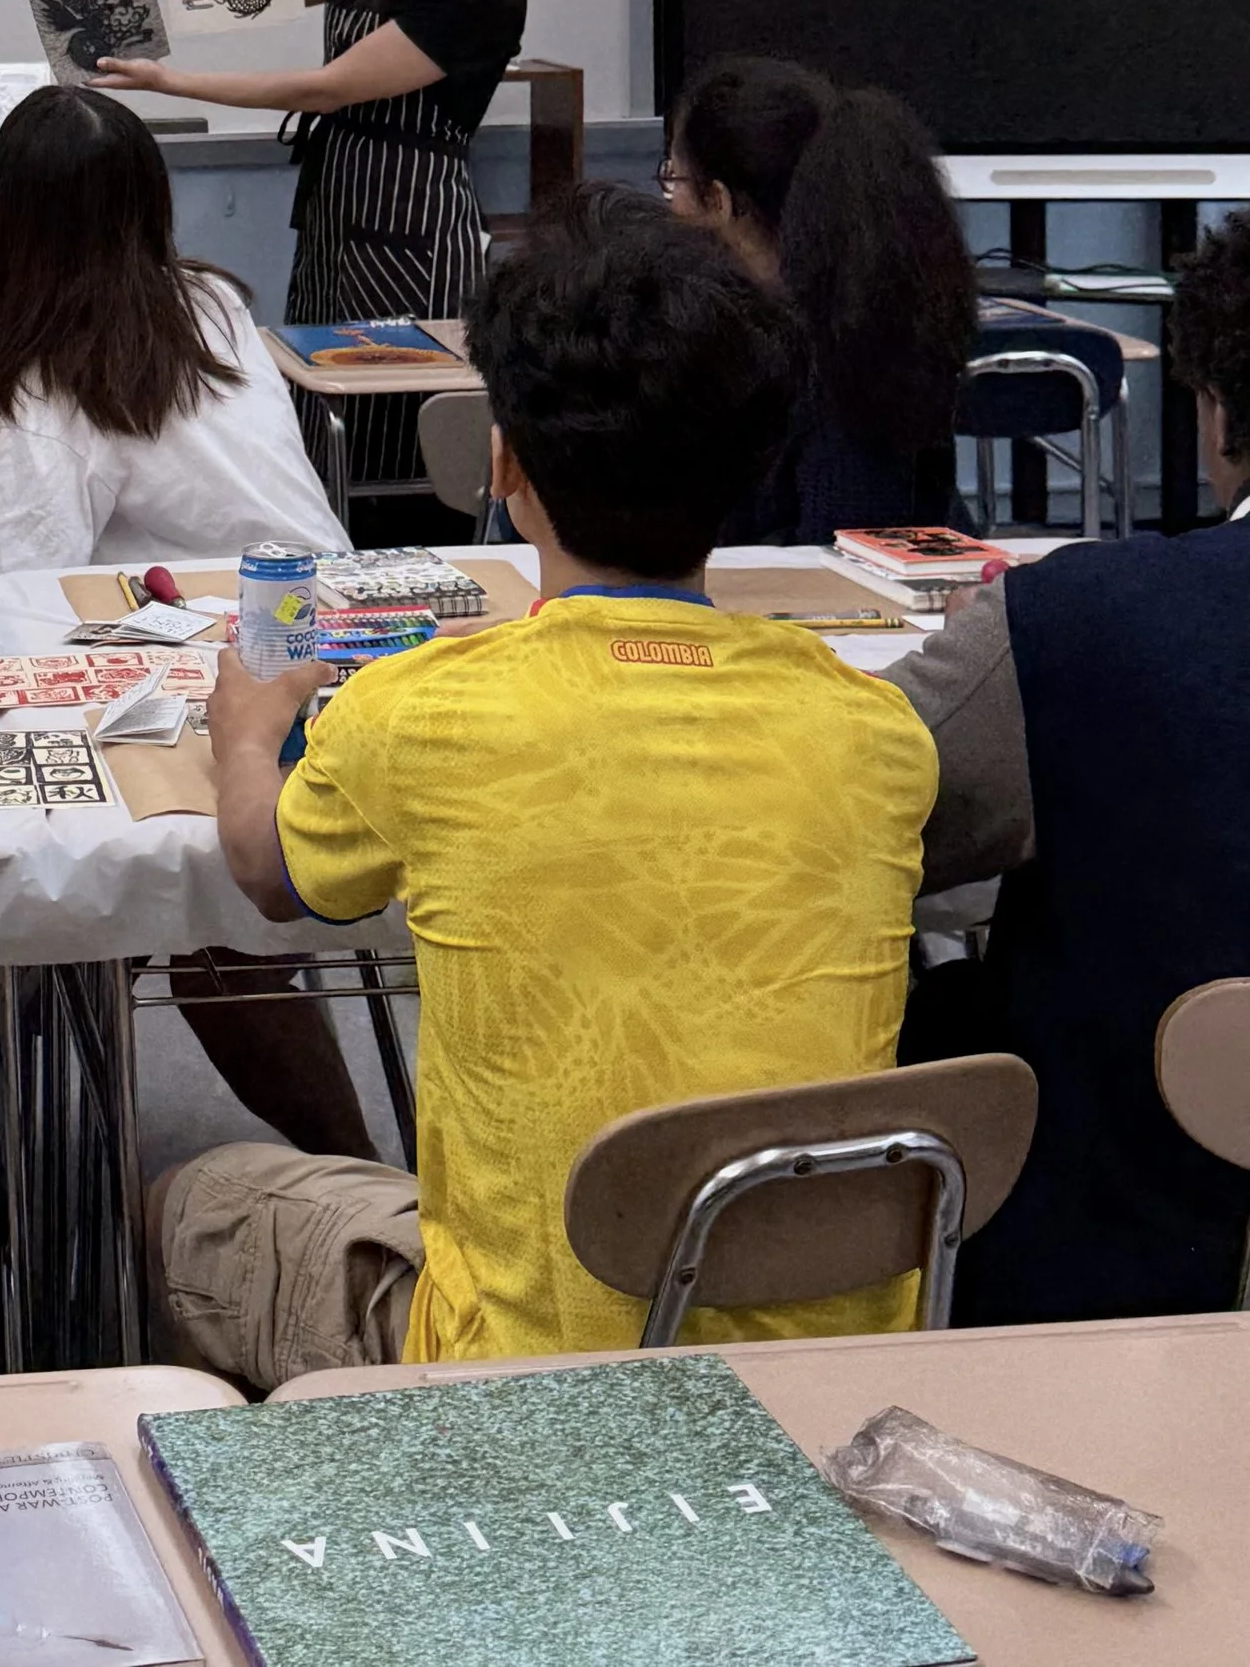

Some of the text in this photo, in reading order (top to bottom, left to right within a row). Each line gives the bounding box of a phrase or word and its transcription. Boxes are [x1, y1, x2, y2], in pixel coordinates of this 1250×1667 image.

[611, 640, 714, 667] COLOMBIA
[47, 785, 95, 800] 秋
[17, 1493, 114, 1511] POST-WAR
